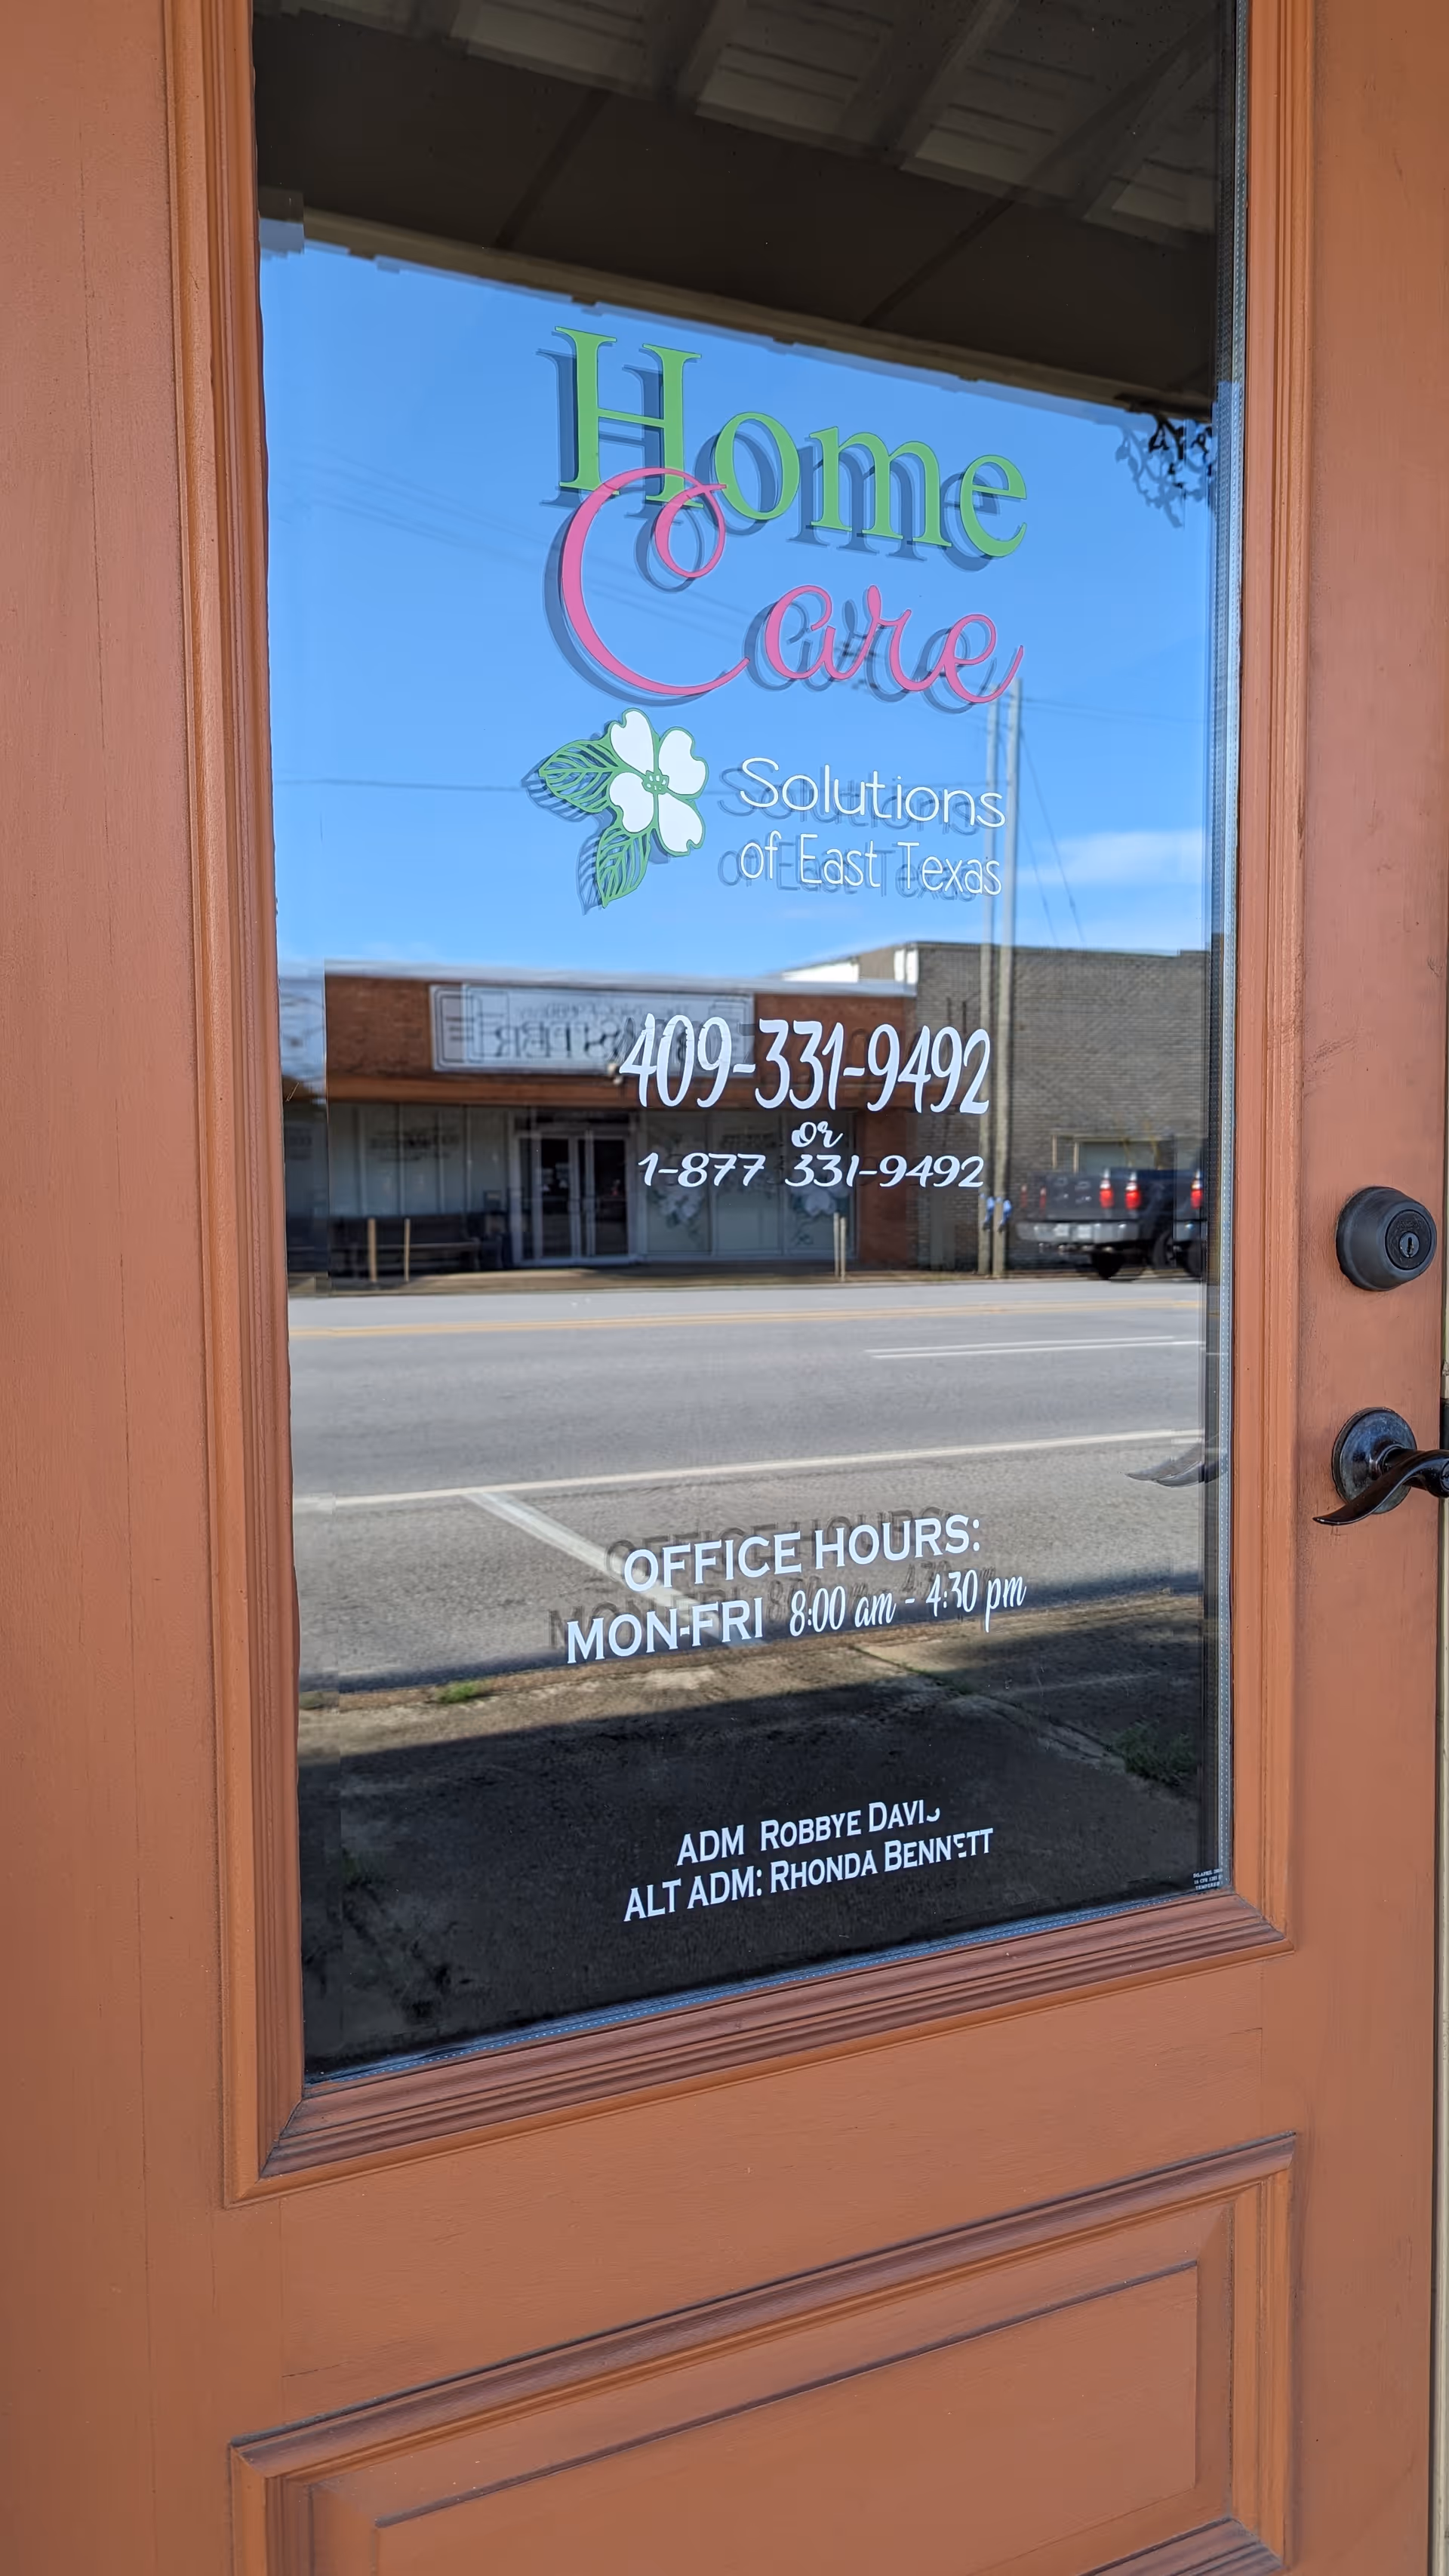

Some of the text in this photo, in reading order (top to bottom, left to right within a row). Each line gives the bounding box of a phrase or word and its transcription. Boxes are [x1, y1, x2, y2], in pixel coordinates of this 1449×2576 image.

[554, 326, 1026, 557] Home
[561, 467, 1024, 703] Care
[740, 757, 1006, 827] Solutions
[740, 830, 1002, 895] of East Texas
[619, 1013, 991, 1114] 409-331-9492
[791, 1121, 843, 1148] or
[638, 1153, 984, 1187] 1-877 331-9492
[623, 1514, 981, 1592] OFFICE HOURS:
[567, 1597, 763, 1663] MON-FRI
[789, 1586, 846, 1636] 8:00
[854, 1590, 896, 1628] am
[925, 1569, 978, 1617] 4:30
[985, 1575, 1027, 1633] pm
[676, 1824, 744, 1866] ADM
[623, 1879, 681, 1922] ALT
[687, 1865, 762, 1910] ADM:
